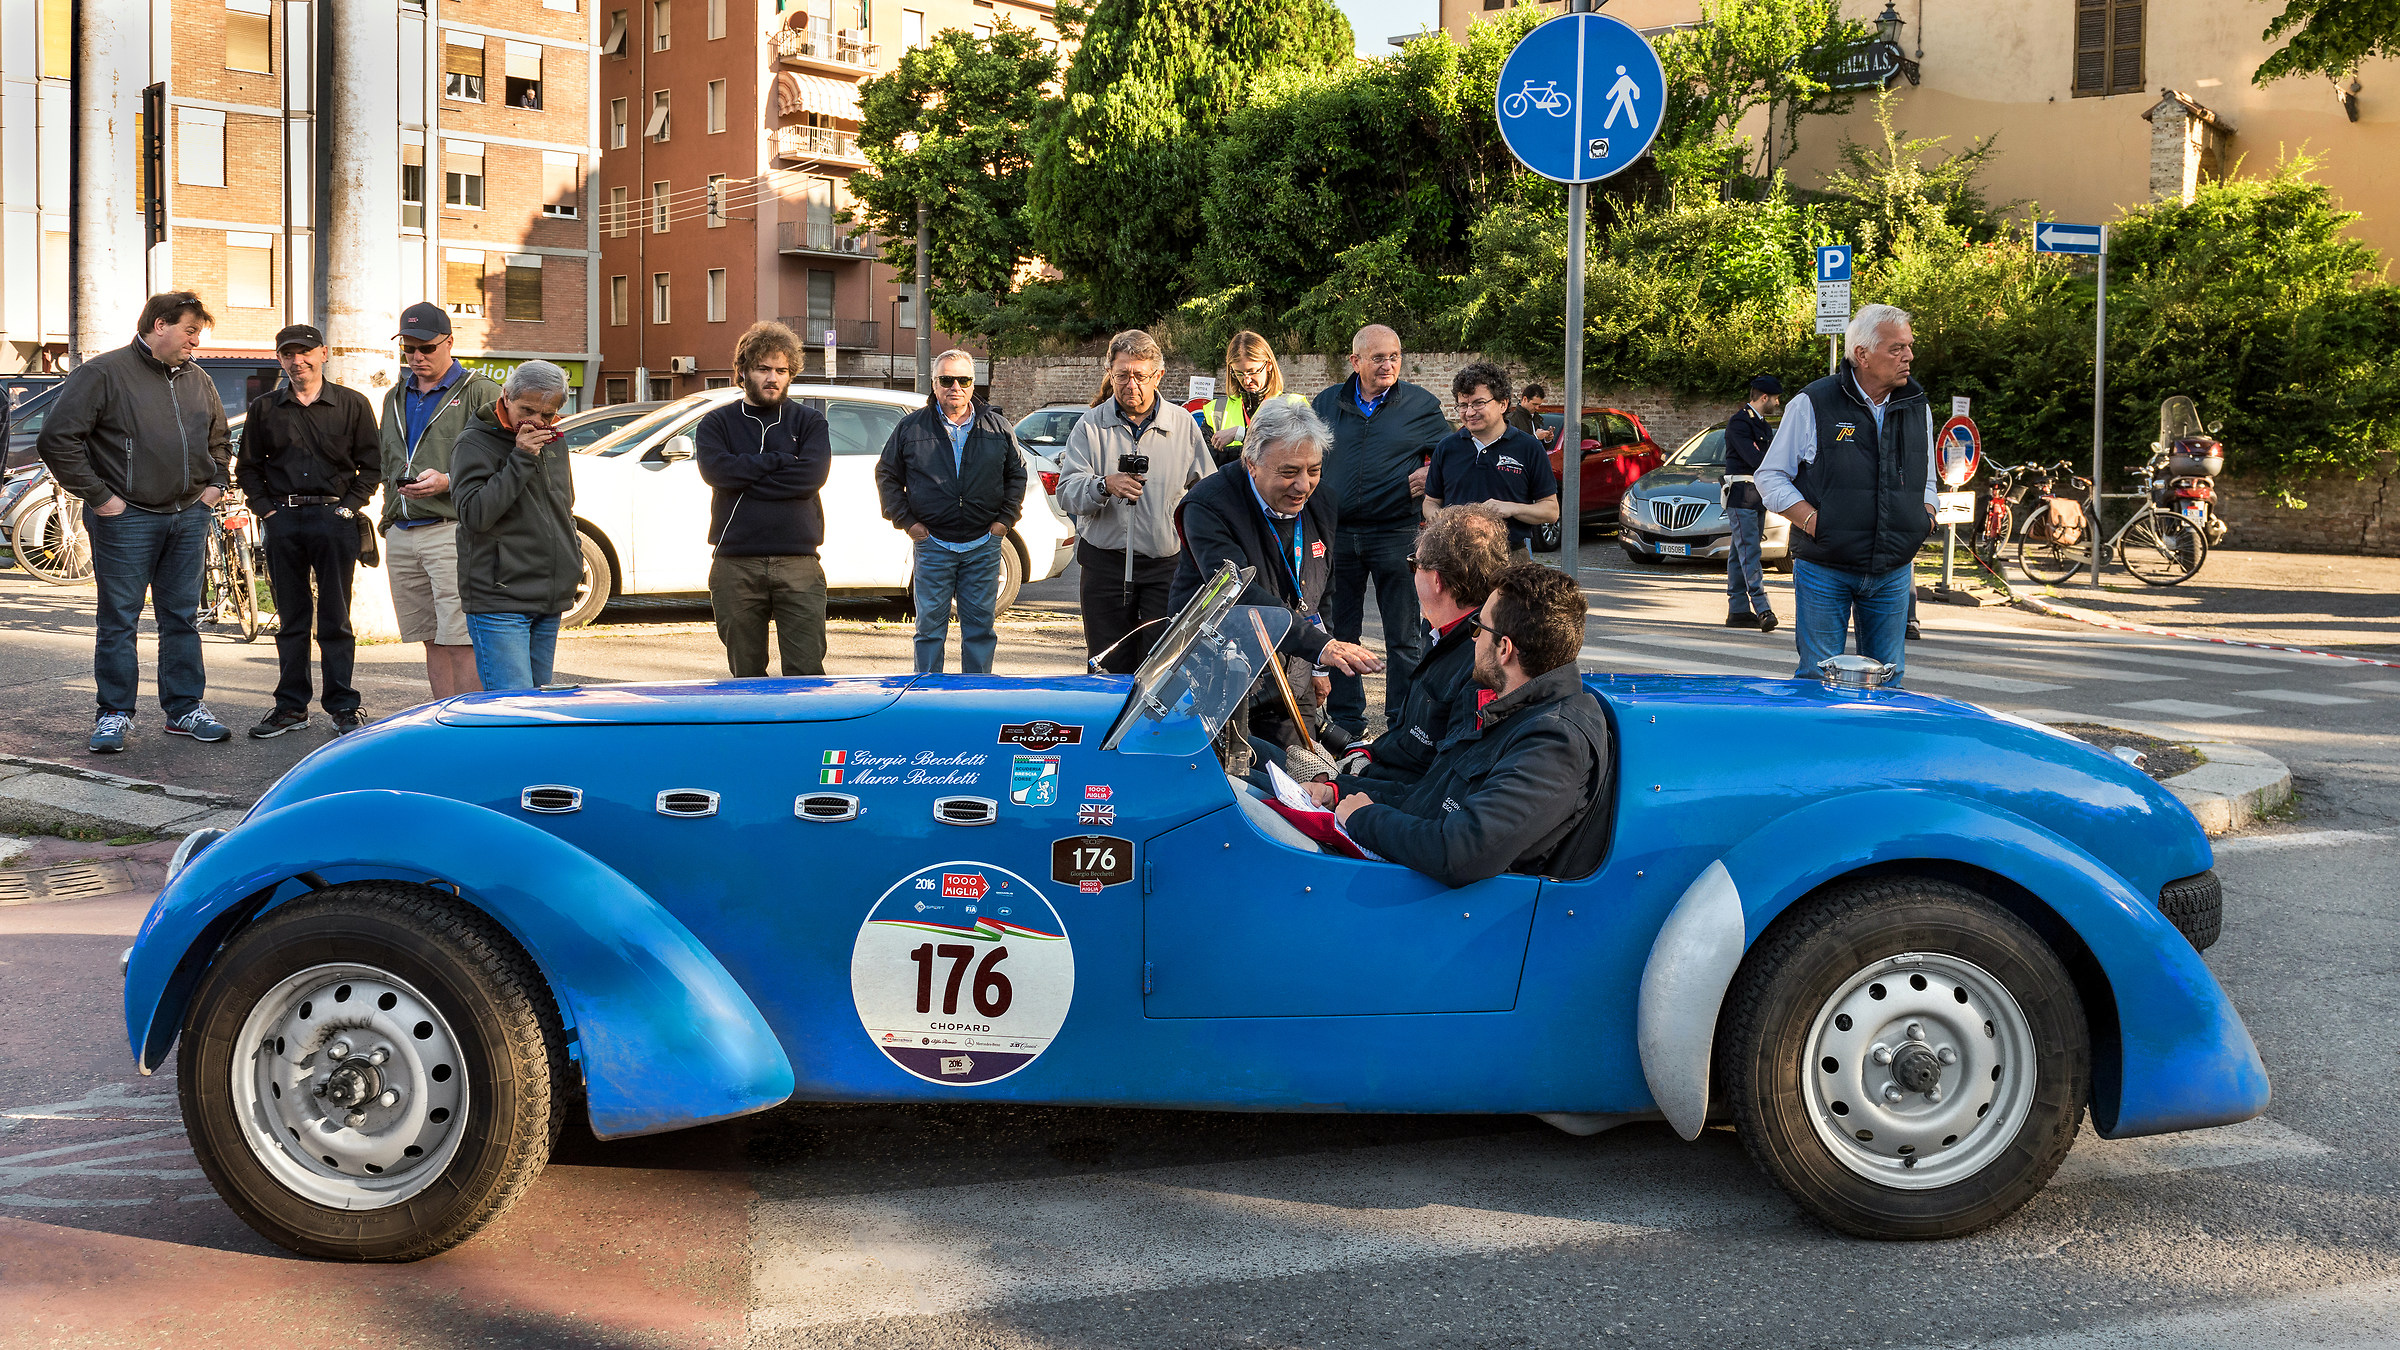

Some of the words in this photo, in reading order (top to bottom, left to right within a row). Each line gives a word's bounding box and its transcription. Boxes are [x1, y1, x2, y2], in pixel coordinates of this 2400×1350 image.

[1873, 52, 1891, 70] A.S.
[1824, 250, 1845, 278] P
[826, 332, 834, 345] P
[851, 750, 907, 770] Giorgio
[910, 750, 988, 766] Becchetti
[848, 768, 899, 785] Marco
[902, 768, 981, 785] Becchetti
[1072, 847, 1116, 871] 176
[915, 878, 936, 890] 2016
[947, 876, 977, 885] 1000
[945, 887, 979, 896] MIGLIA
[965, 905, 977, 914] FIA
[910, 943, 1013, 1018] 176
[930, 1022, 991, 1032] CHOPARD
[948, 1059, 963, 1068] 2016
[441, 1168, 496, 1227] MICHELIN
